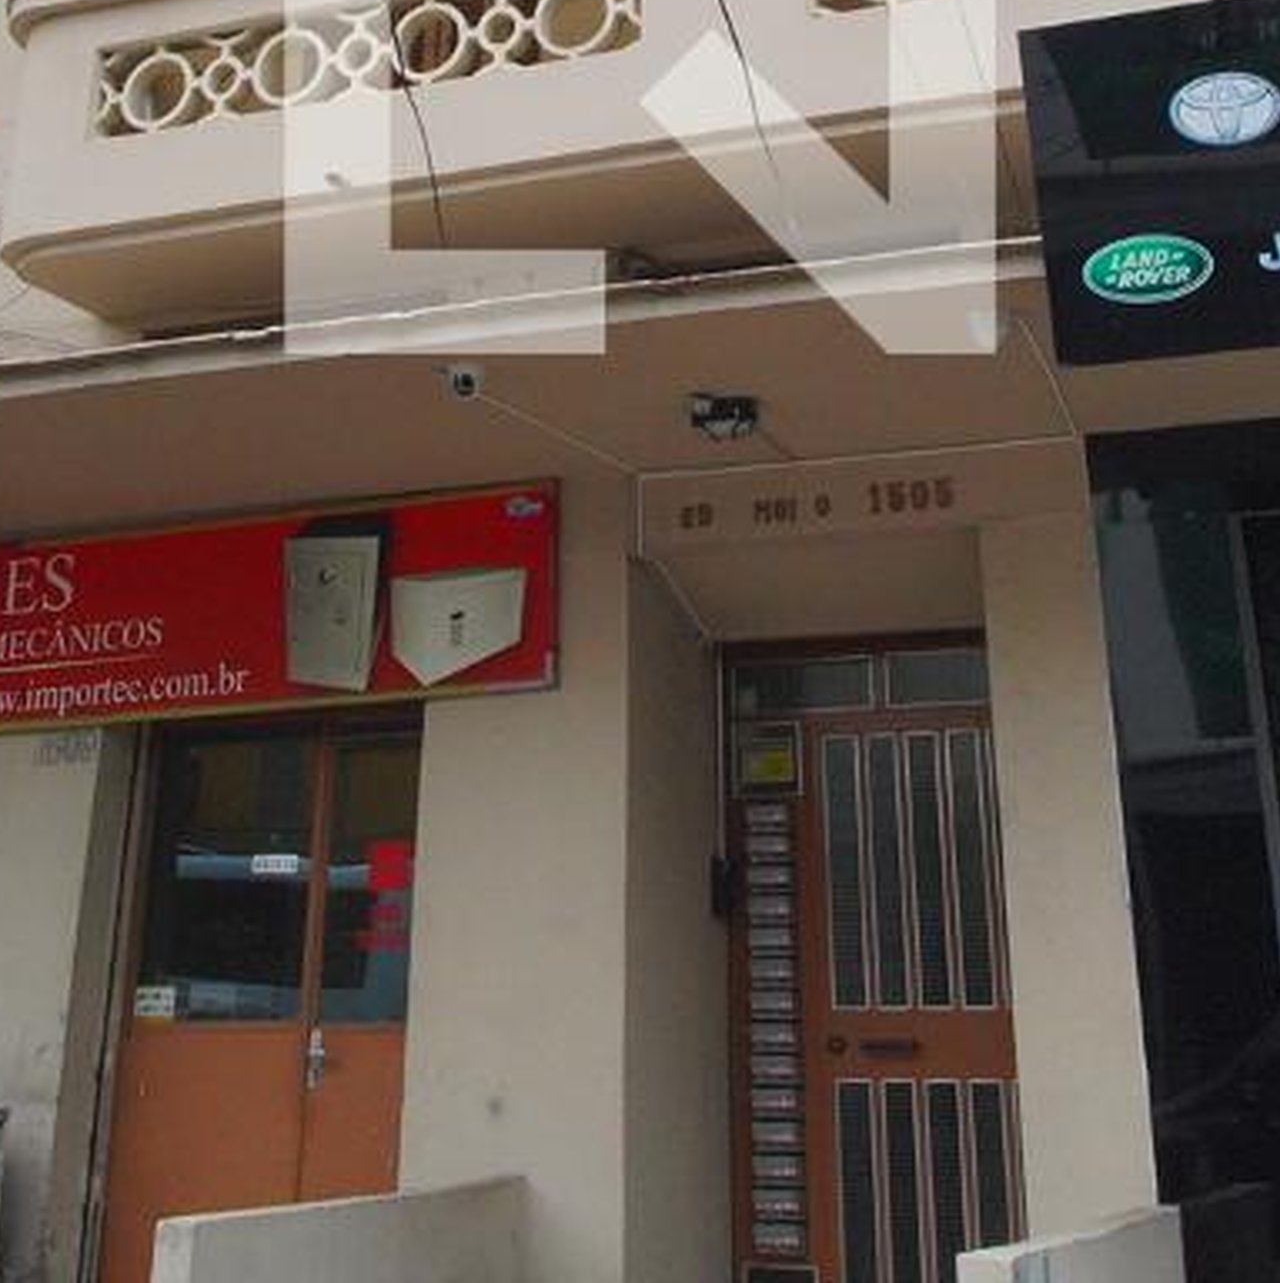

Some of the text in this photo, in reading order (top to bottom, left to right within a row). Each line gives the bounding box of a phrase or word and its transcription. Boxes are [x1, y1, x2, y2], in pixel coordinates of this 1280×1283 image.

[1109, 249, 1169, 272] LAND
[1117, 263, 1191, 289] ROVER
[869, 476, 954, 515] 1505
